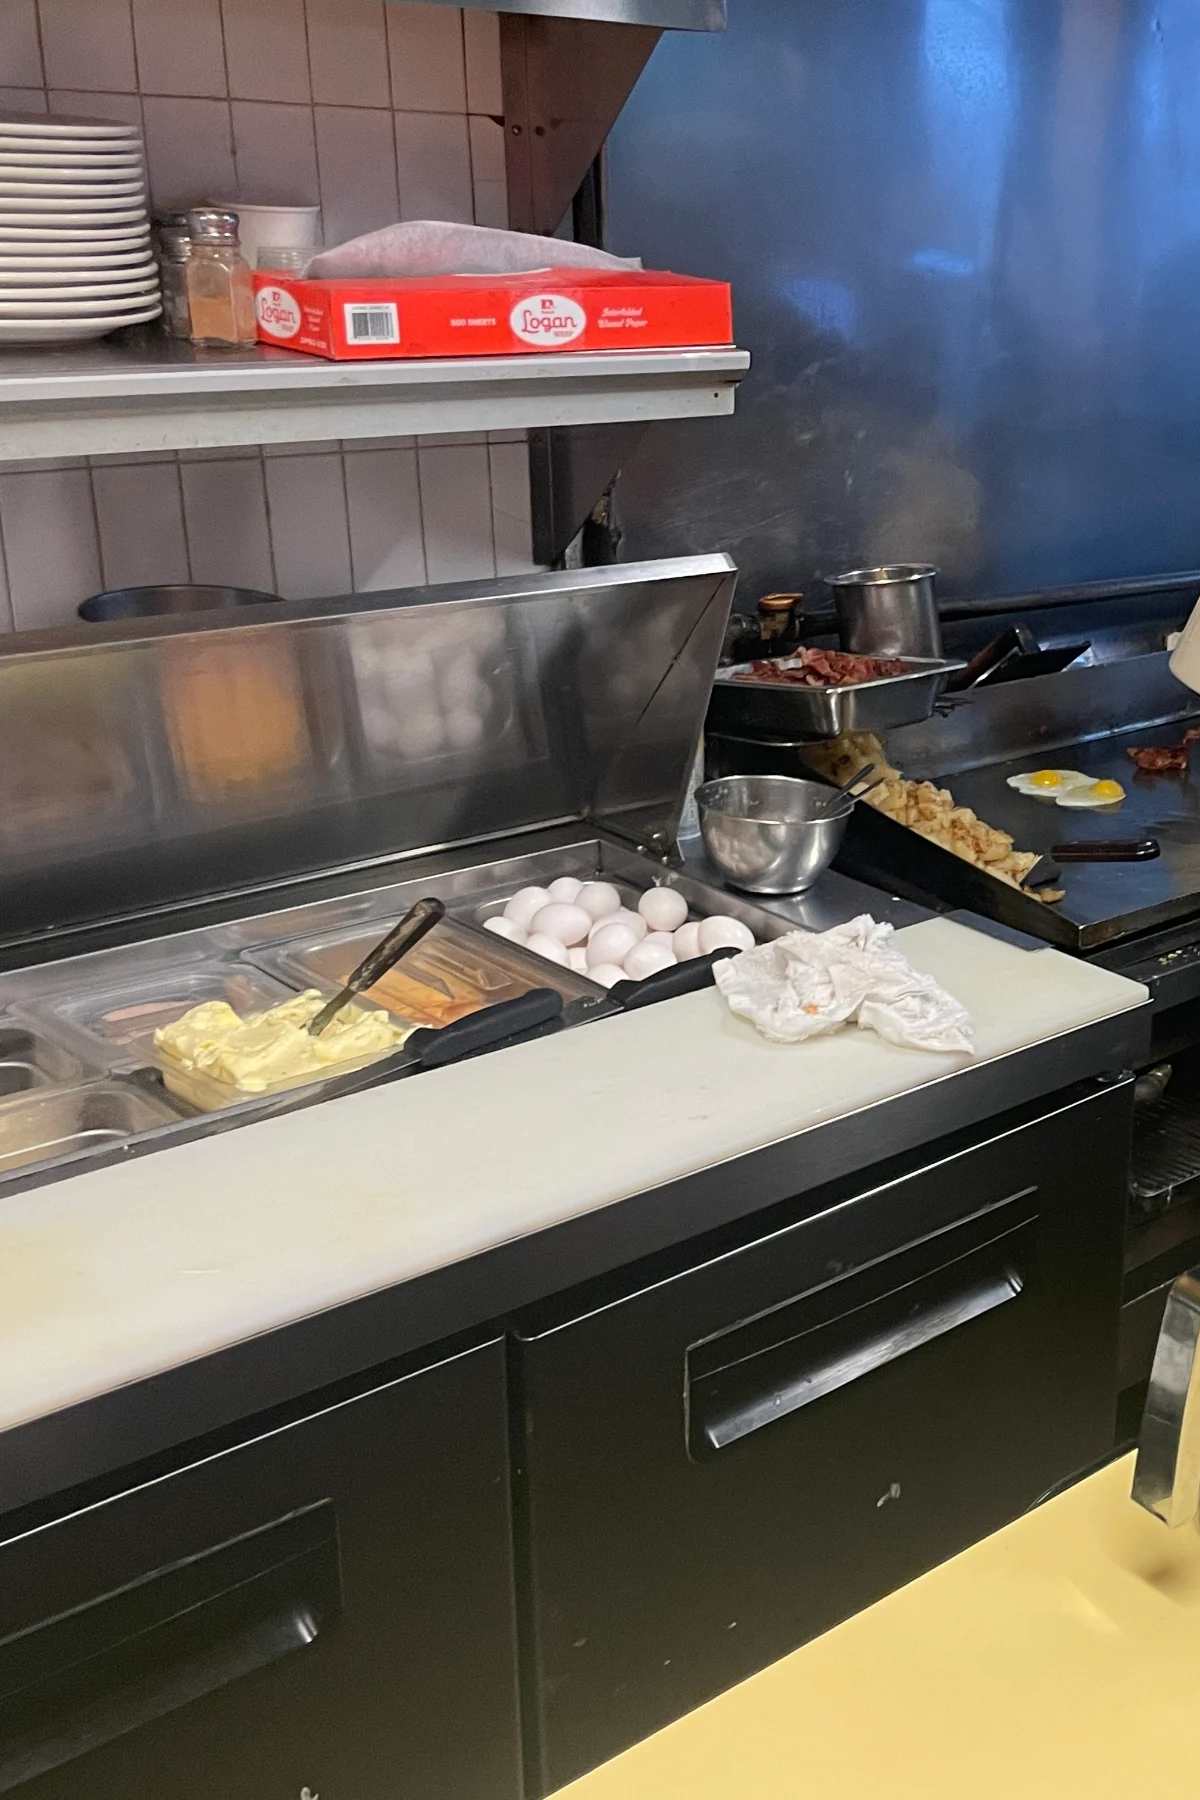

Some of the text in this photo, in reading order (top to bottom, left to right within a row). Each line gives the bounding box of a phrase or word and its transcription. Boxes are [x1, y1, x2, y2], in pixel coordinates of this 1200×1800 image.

[260, 297, 297, 324] Logan
[468, 318, 497, 327] SHEETS
[521, 309, 577, 334] Logan
